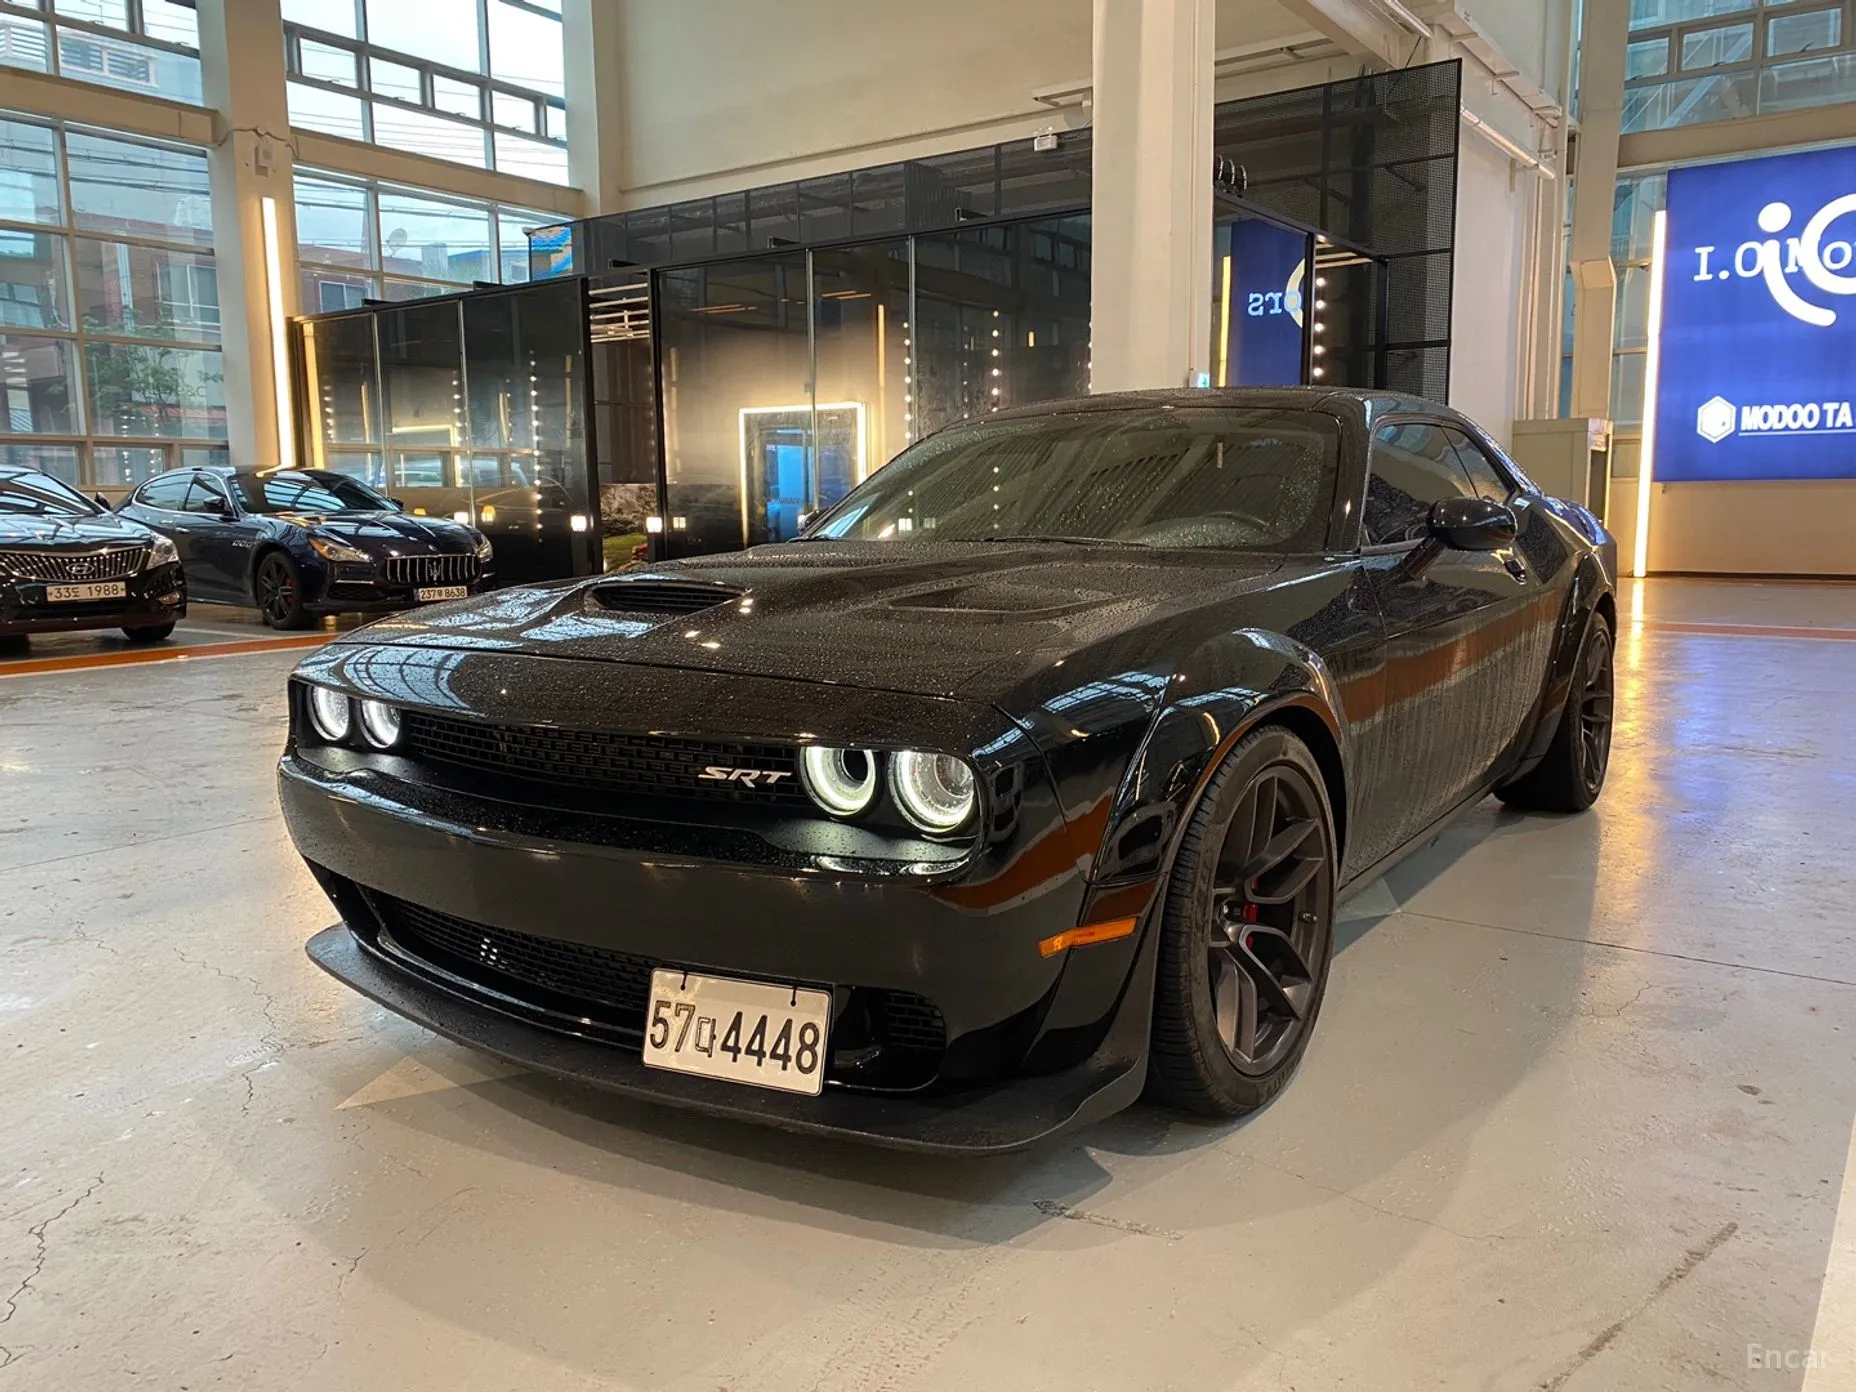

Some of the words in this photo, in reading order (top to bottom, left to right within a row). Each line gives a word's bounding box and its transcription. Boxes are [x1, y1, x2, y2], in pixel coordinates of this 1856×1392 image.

[1741, 403, 1820, 431] MODOO
[87, 584, 119, 597] 1988
[697, 766, 793, 788] SRT
